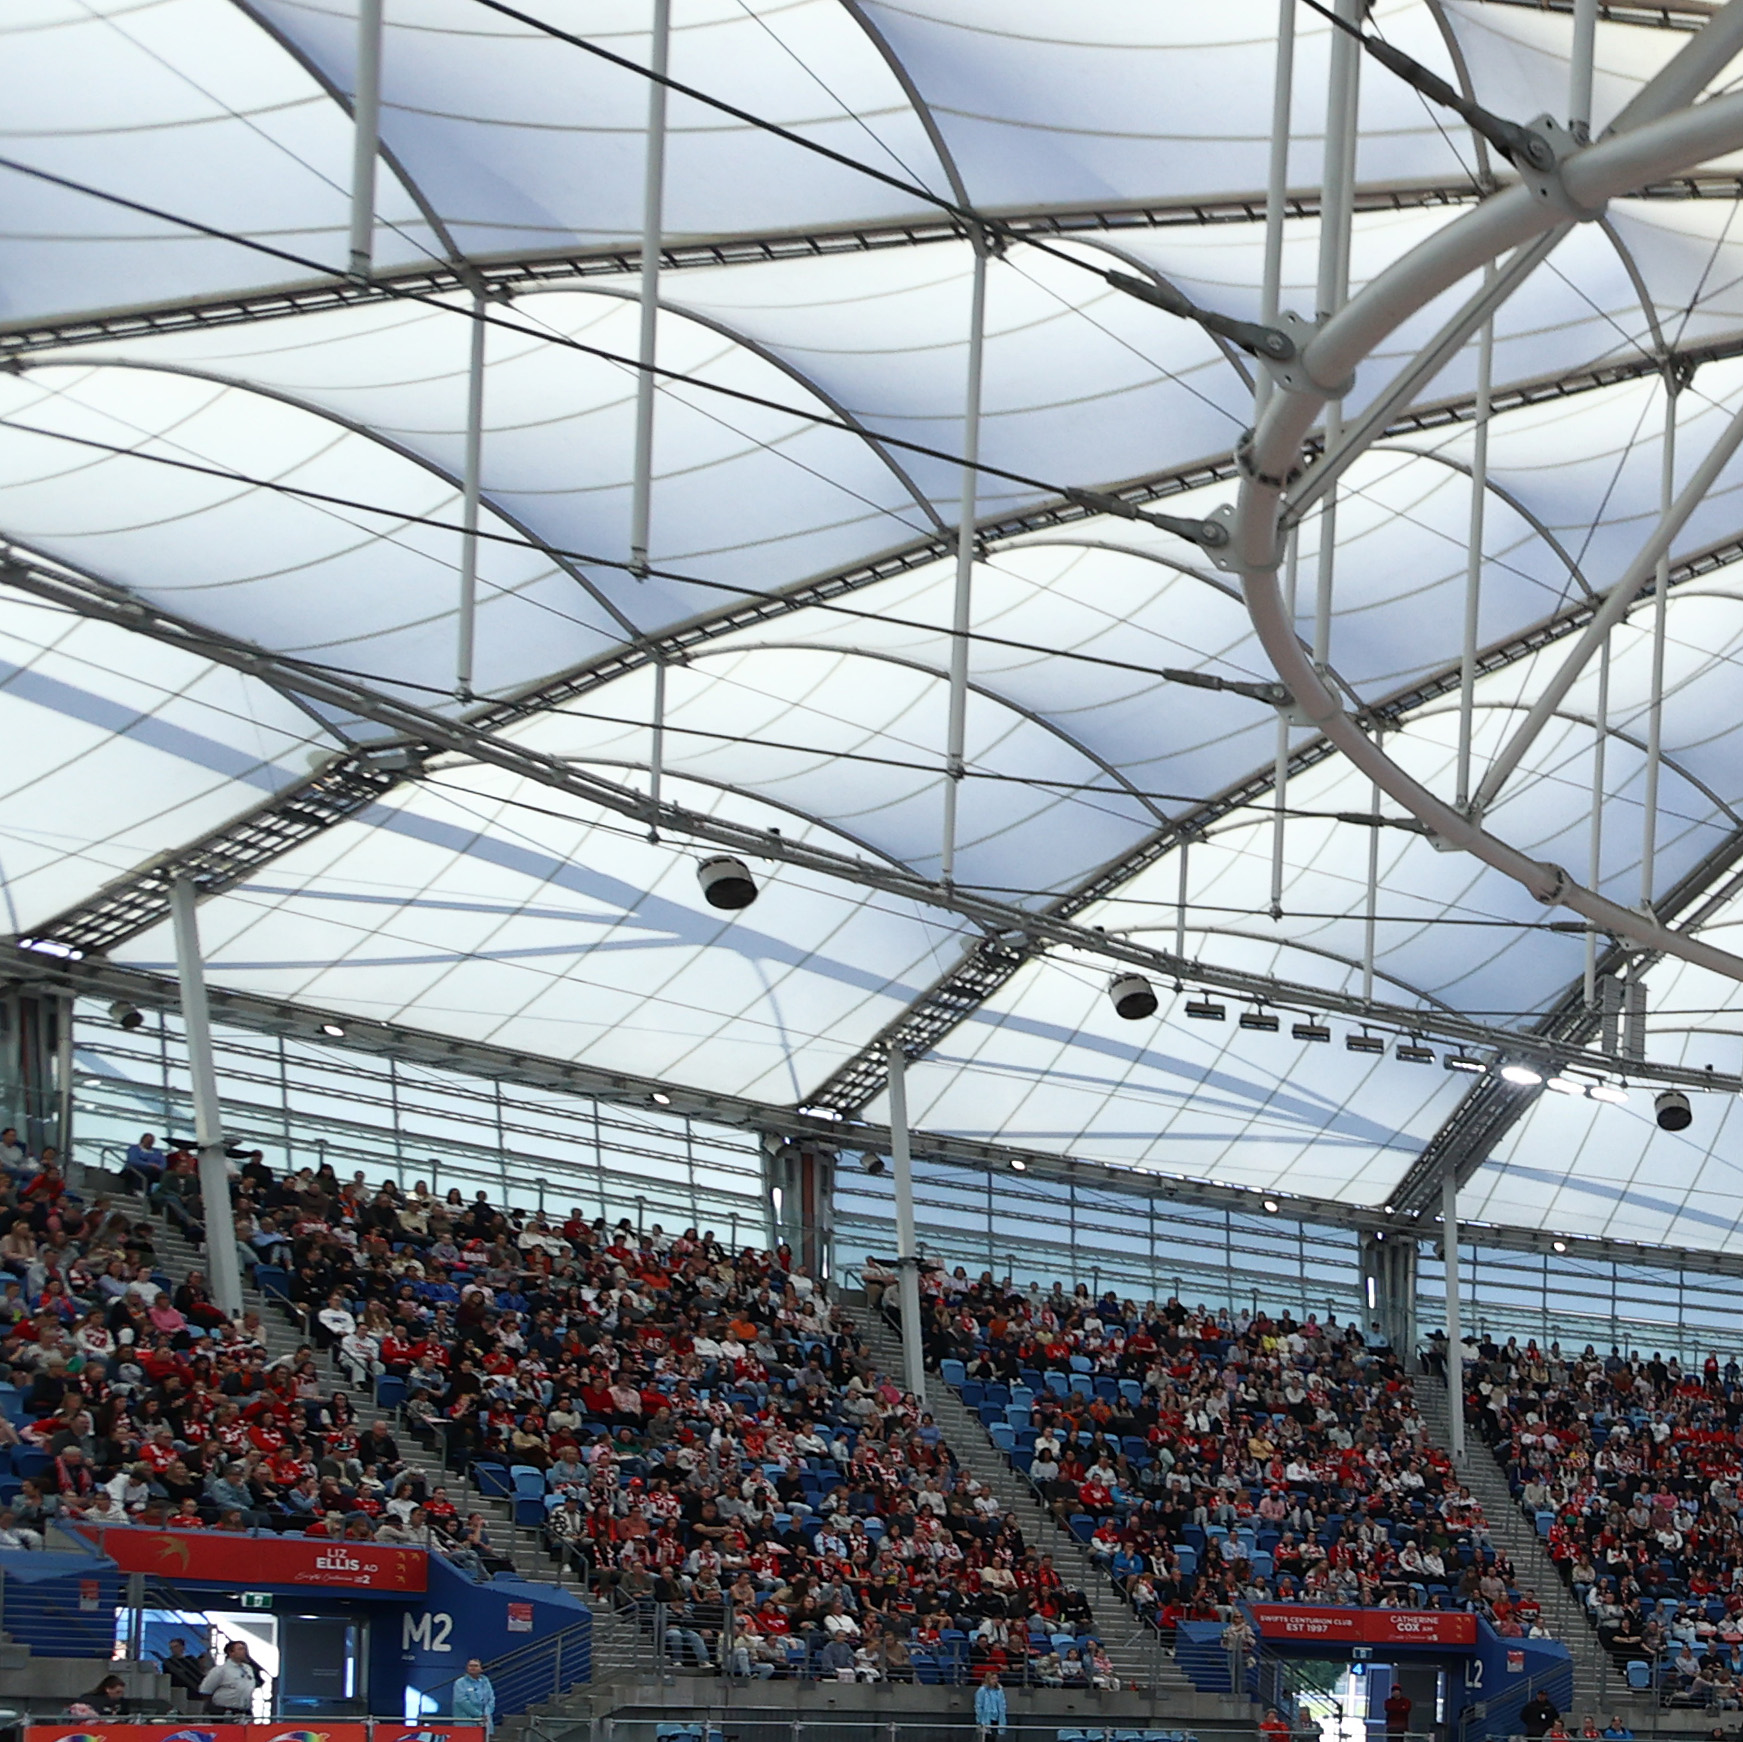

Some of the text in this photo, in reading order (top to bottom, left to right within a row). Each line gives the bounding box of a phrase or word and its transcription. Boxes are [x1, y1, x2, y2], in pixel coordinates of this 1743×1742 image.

[327, 1548, 347, 1558] LIZ
[316, 1557, 360, 1571] ELLIS
[1290, 1616, 1333, 1625] CENTURION
[1390, 1615, 1439, 1624] CATHERINE
[402, 1612, 453, 1652] M2
[1286, 1623, 1328, 1633] EST 1997
[1397, 1623, 1420, 1632] COX
[1464, 1658, 1482, 1688] L2
